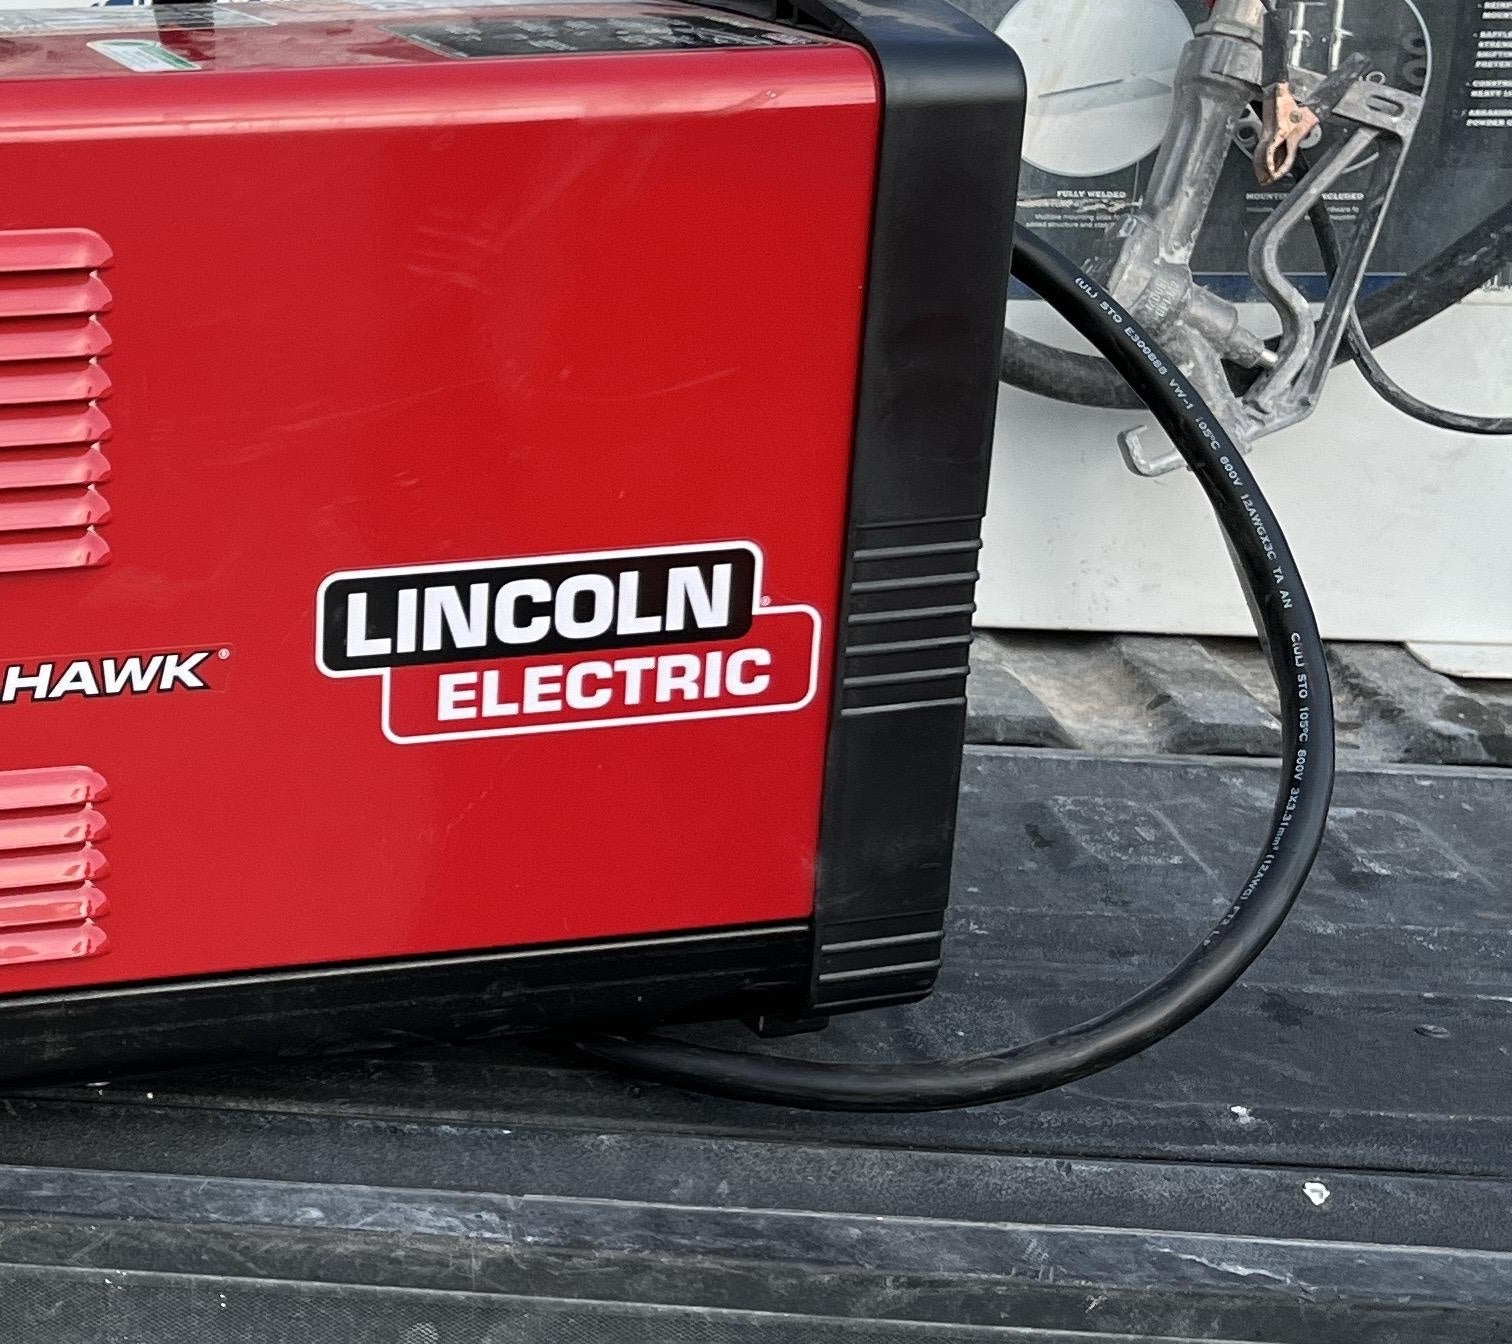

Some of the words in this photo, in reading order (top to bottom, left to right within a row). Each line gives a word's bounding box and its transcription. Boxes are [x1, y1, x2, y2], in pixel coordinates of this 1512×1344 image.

[1056, 190, 1086, 198] FULLY
[1087, 190, 1127, 198] WELDED
[1321, 192, 1365, 201] NCLUDED
[1074, 276, 1099, 299] (UL)
[1099, 300, 1123, 324] STO
[1169, 378, 1194, 410] VW-1
[1297, 673, 1308, 699] STO
[345, 563, 733, 658] LINCOLN
[436, 647, 773, 722] ELECTRIC
